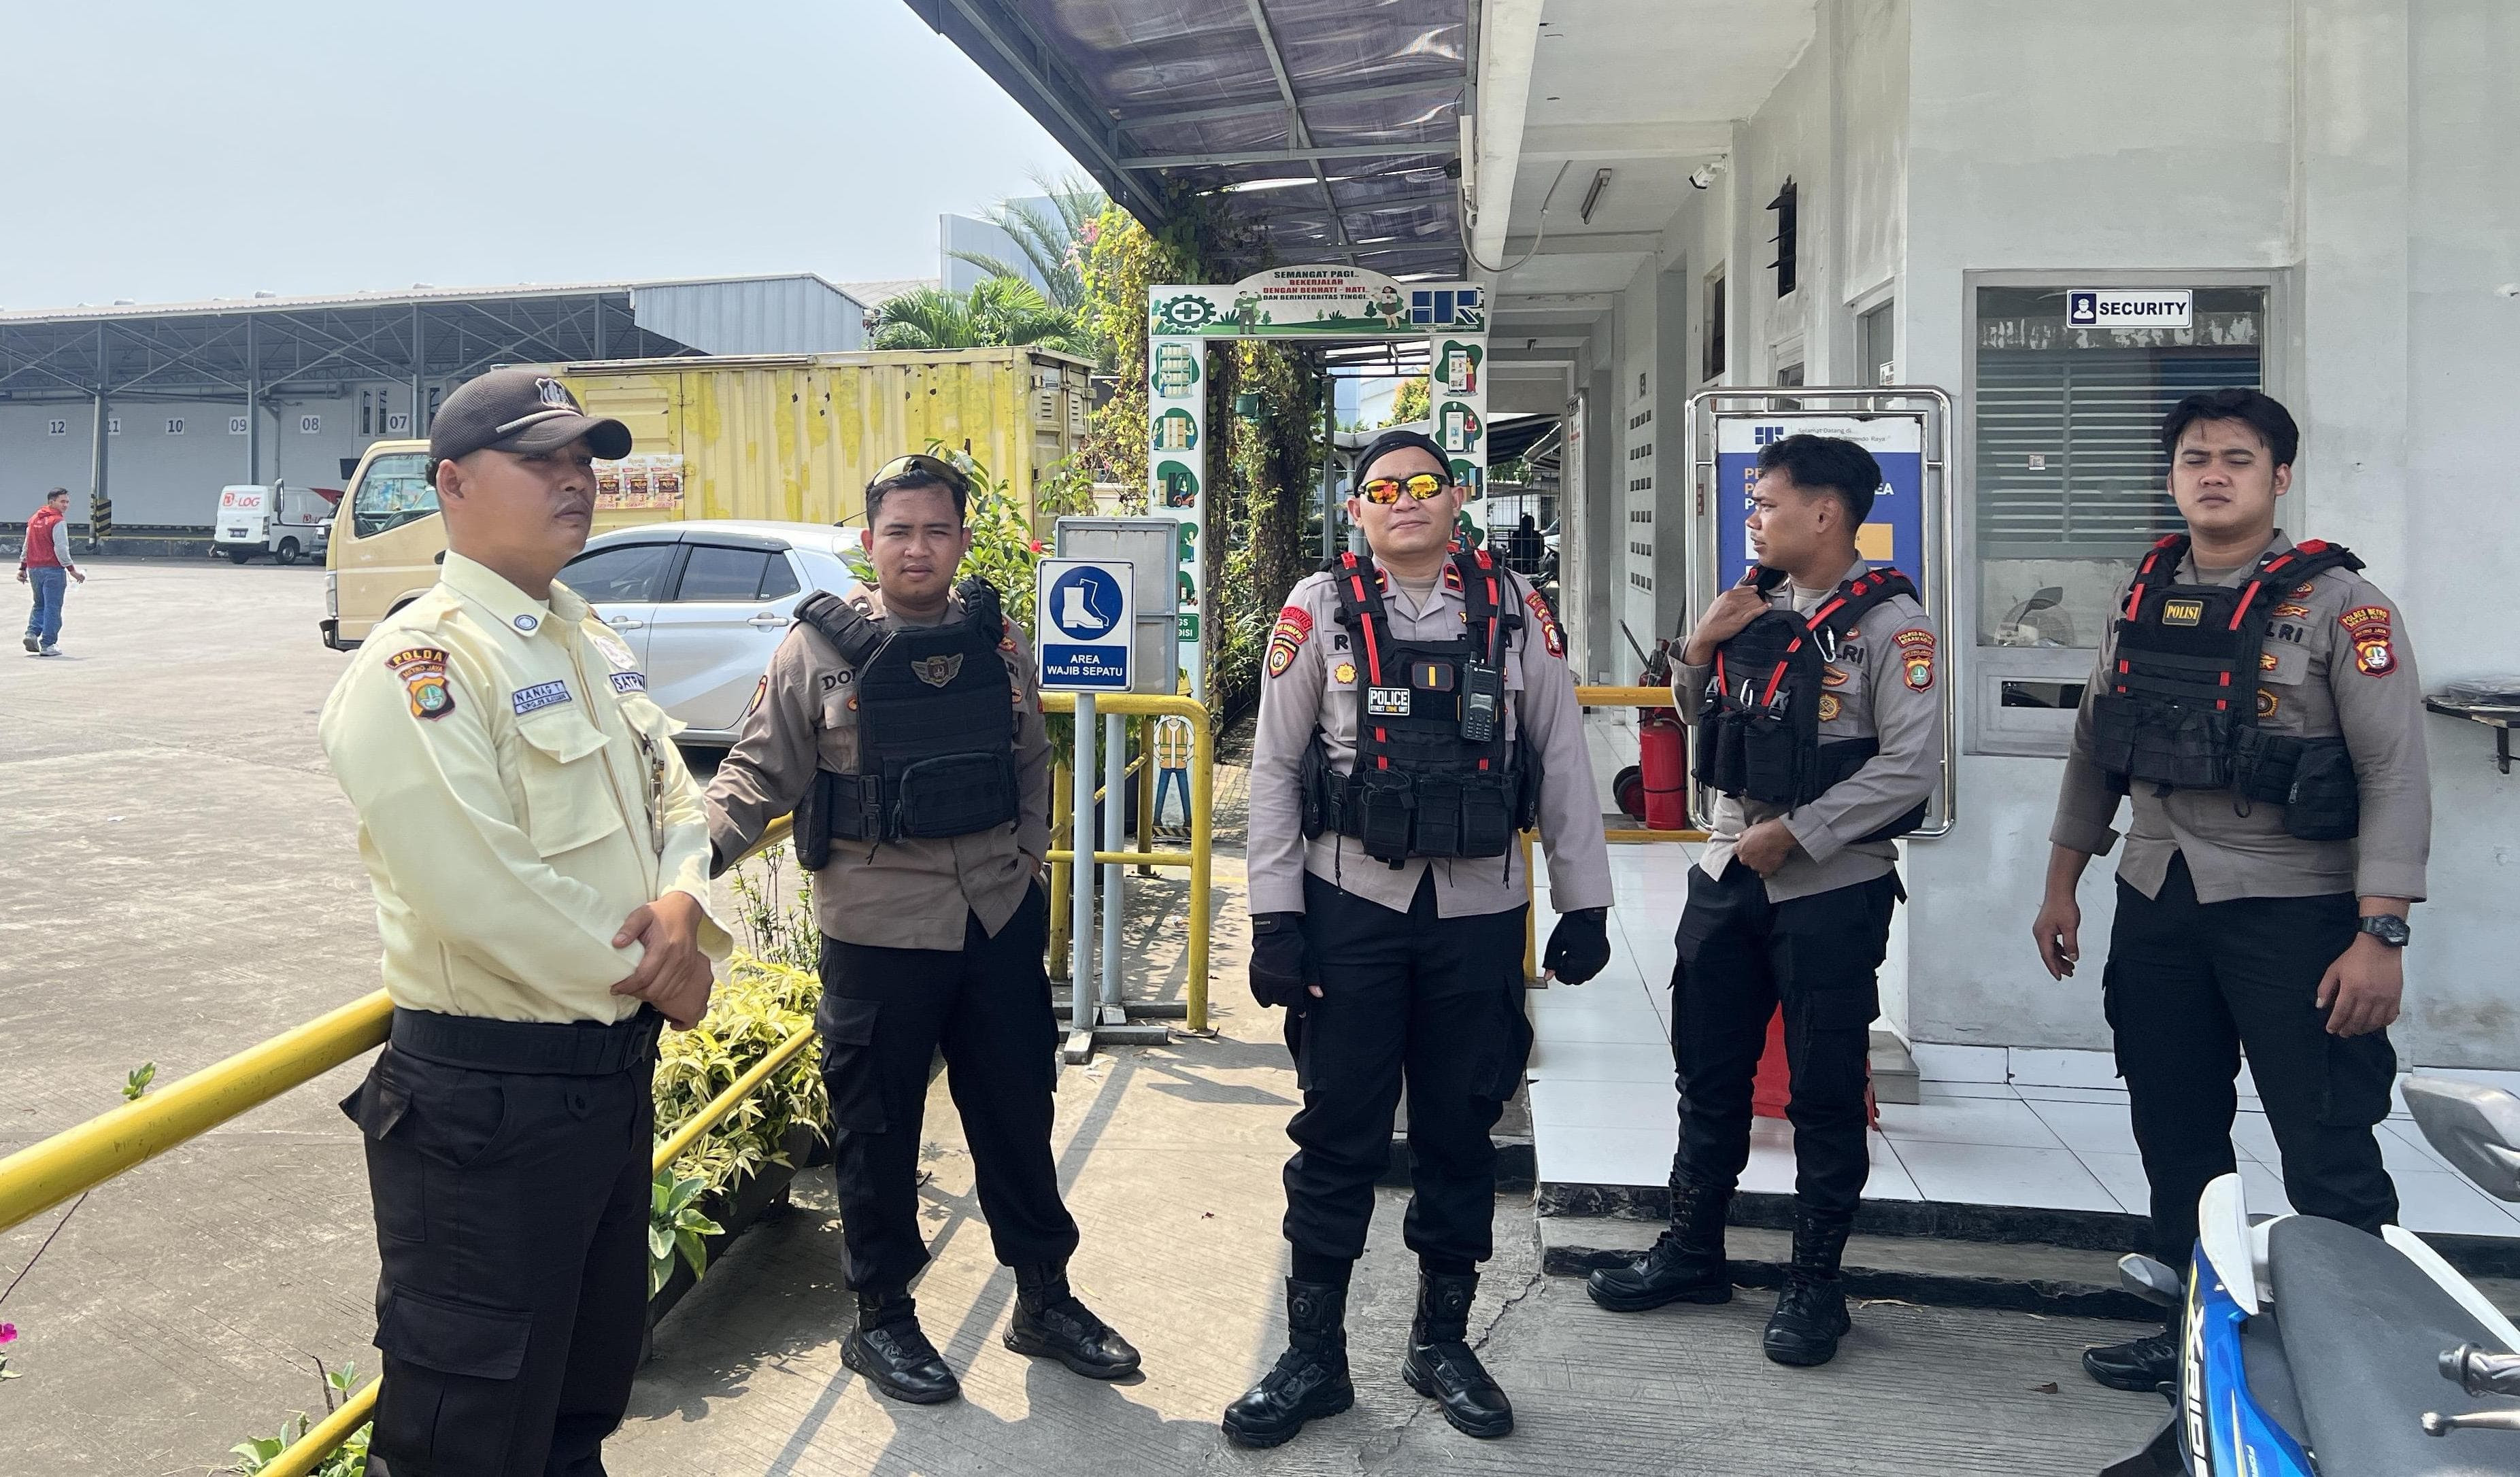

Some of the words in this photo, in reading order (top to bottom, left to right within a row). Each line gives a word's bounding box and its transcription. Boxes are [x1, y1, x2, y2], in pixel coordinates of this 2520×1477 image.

[2099, 302, 2187, 316] SECURITY
[50, 421, 65, 434] 12
[167, 420, 184, 433] 10
[231, 419, 247, 432] 09
[302, 418, 319, 431] 08
[389, 415, 407, 430] 07
[223, 492, 261, 507] B-LOG
[2166, 605, 2200, 619] POLISI
[2342, 609, 2366, 624] POLRES
[2264, 621, 2304, 643] LRI
[392, 649, 443, 666] POLDA
[1070, 655, 1100, 664] AREA
[1047, 665, 1080, 676] WAJIB
[1082, 666, 1123, 677] SEPATU
[1371, 690, 1408, 706] POLICE
